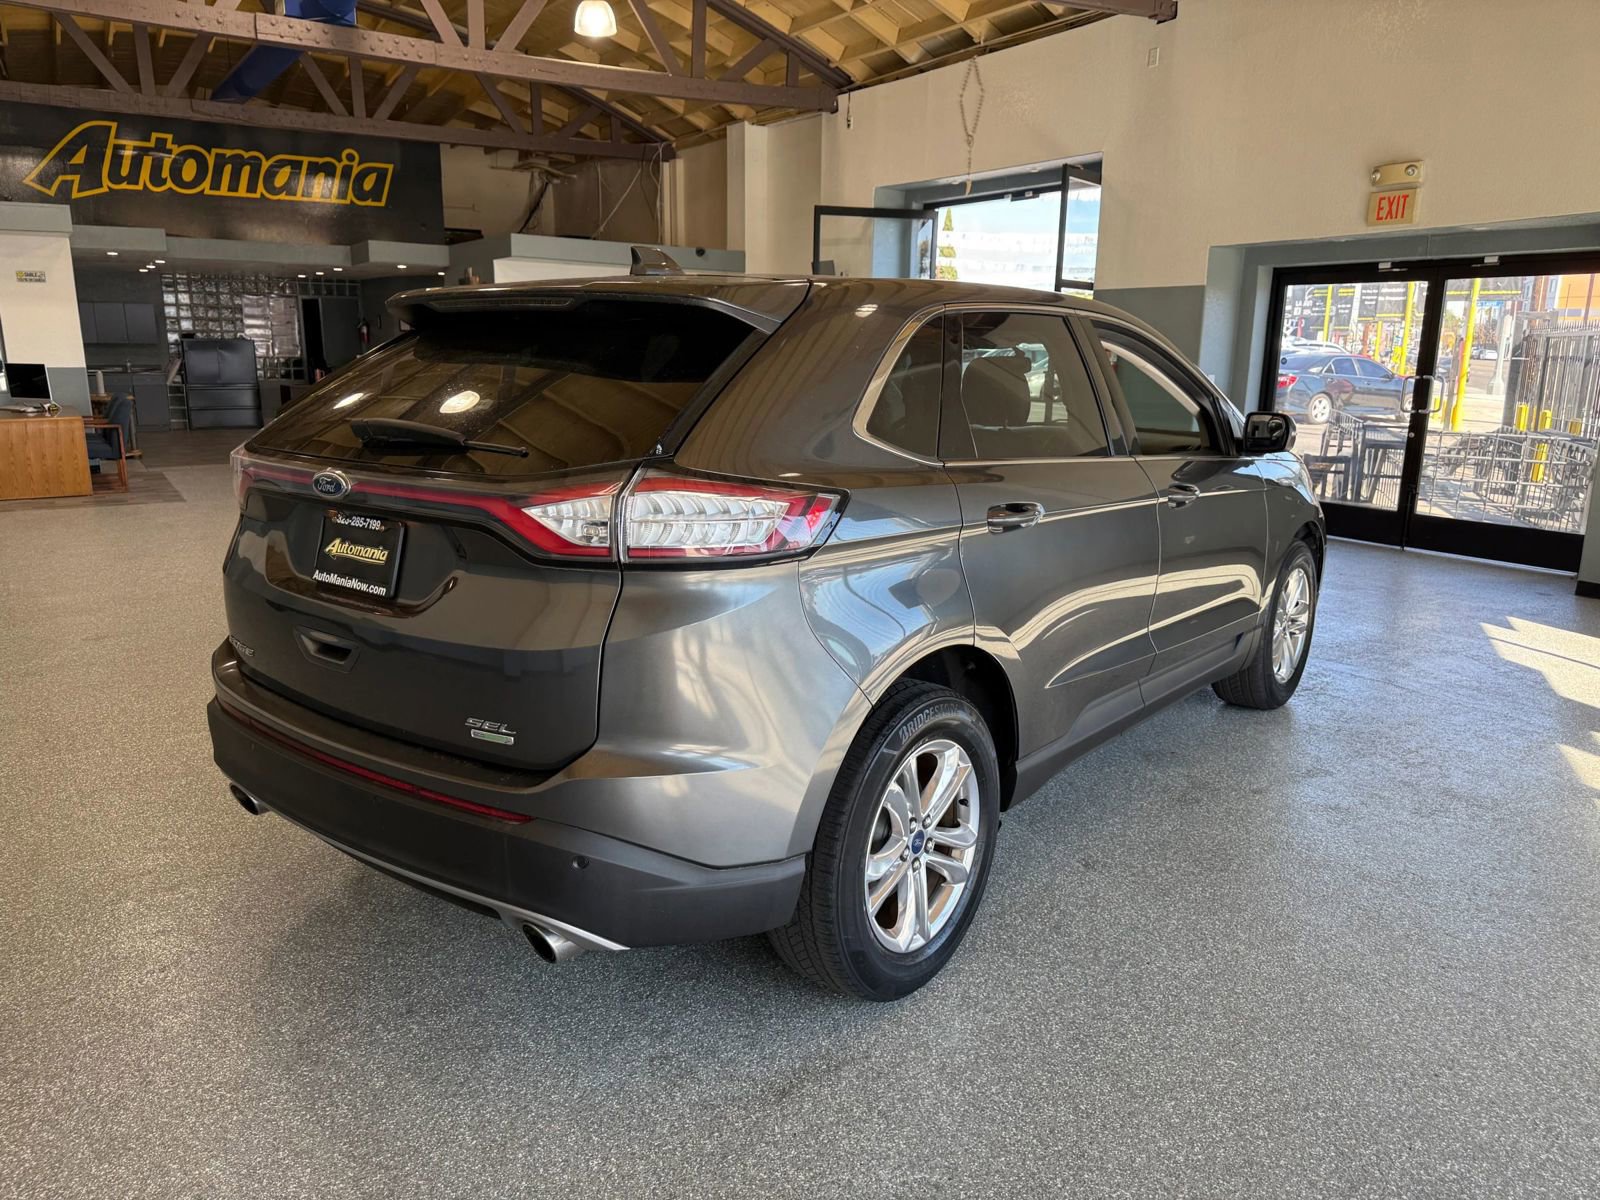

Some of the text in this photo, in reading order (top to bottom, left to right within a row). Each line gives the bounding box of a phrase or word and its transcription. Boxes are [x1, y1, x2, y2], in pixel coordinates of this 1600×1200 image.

[23, 120, 394, 206] Automania
[1376, 194, 1409, 221] EXIT
[324, 537, 389, 561] Automania
[312, 569, 387, 597] AutoManiaNow.com
[465, 717, 517, 734] SEL
